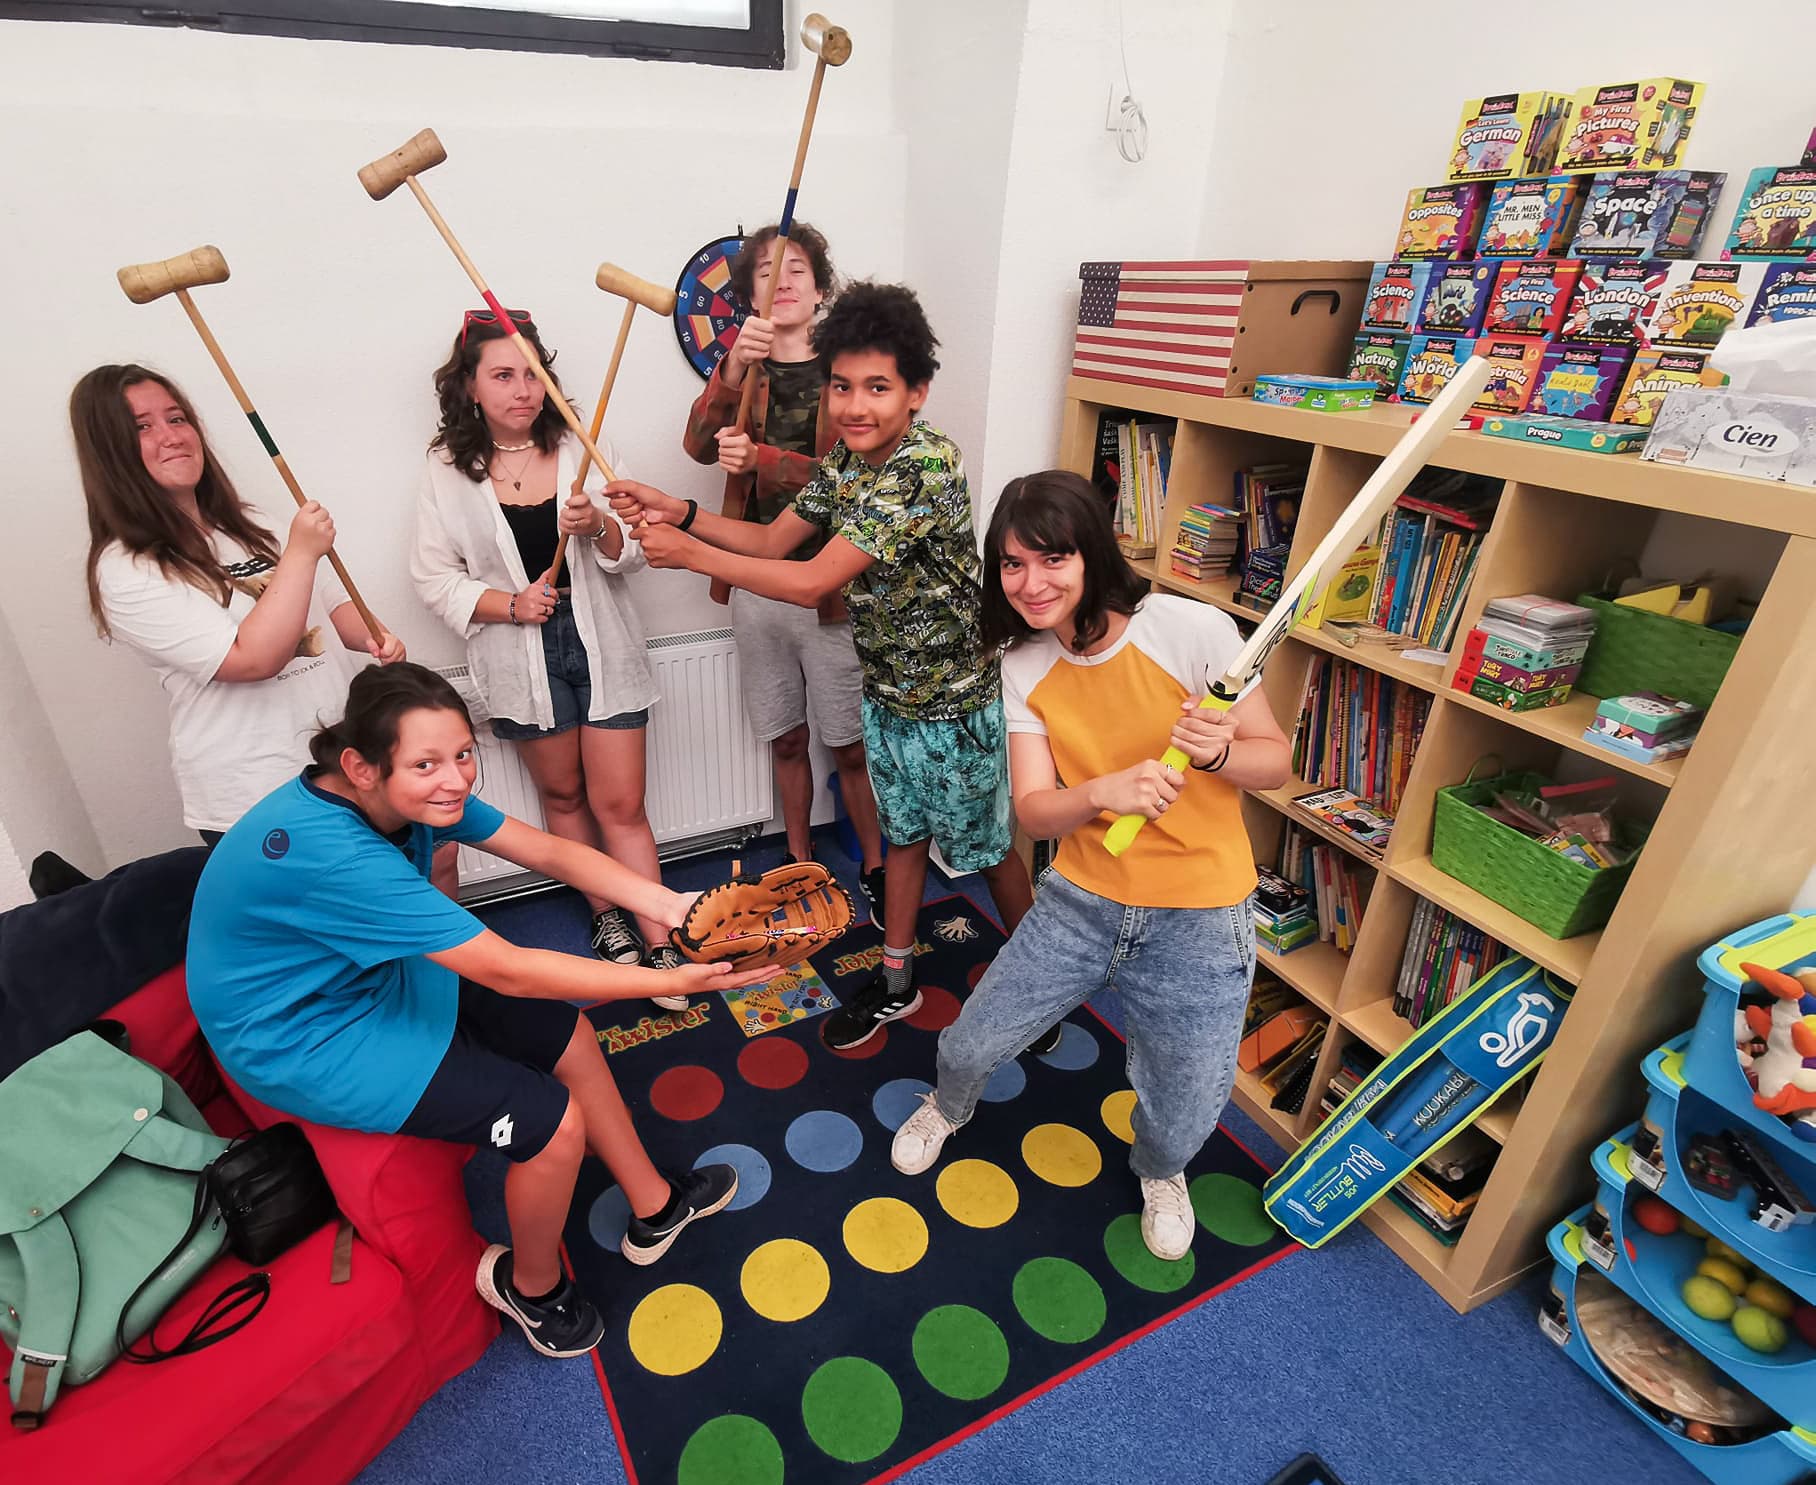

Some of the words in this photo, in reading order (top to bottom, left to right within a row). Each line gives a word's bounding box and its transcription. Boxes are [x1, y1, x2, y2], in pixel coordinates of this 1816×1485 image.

[1595, 108, 1609, 117] My
[1610, 105, 1632, 114] First
[1577, 118, 1640, 137] Pictures
[1460, 128, 1522, 147] German
[1594, 197, 1657, 216] Space
[1749, 191, 1791, 209] Once
[1794, 190, 1816, 203] up
[1408, 203, 1464, 221] Opposites
[1498, 213, 1519, 221] LITTLE
[1521, 212, 1542, 220] MISS
[1762, 208, 1773, 218] a
[1775, 204, 1811, 218] time
[700, 253, 710, 264] 10
[678, 290, 689, 300] 5
[1372, 284, 1415, 299] Science
[1501, 288, 1555, 305] Science
[1584, 288, 1650, 308] London
[696, 295, 705, 308] 60
[1667, 290, 1744, 312] Inventions
[716, 319, 725, 330] 80
[682, 331, 691, 343] 10
[1355, 353, 1398, 370] Nature
[1412, 360, 1457, 379] World
[704, 366, 713, 376] 5
[1489, 366, 1527, 385] stralia
[1526, 427, 1562, 440] Prague
[1723, 424, 1778, 448] Cien
[744, 1000, 766, 1010] RIGHT
[597, 1002, 711, 1054] Twister
[1311, 1175, 1354, 1213] BUTTLER
